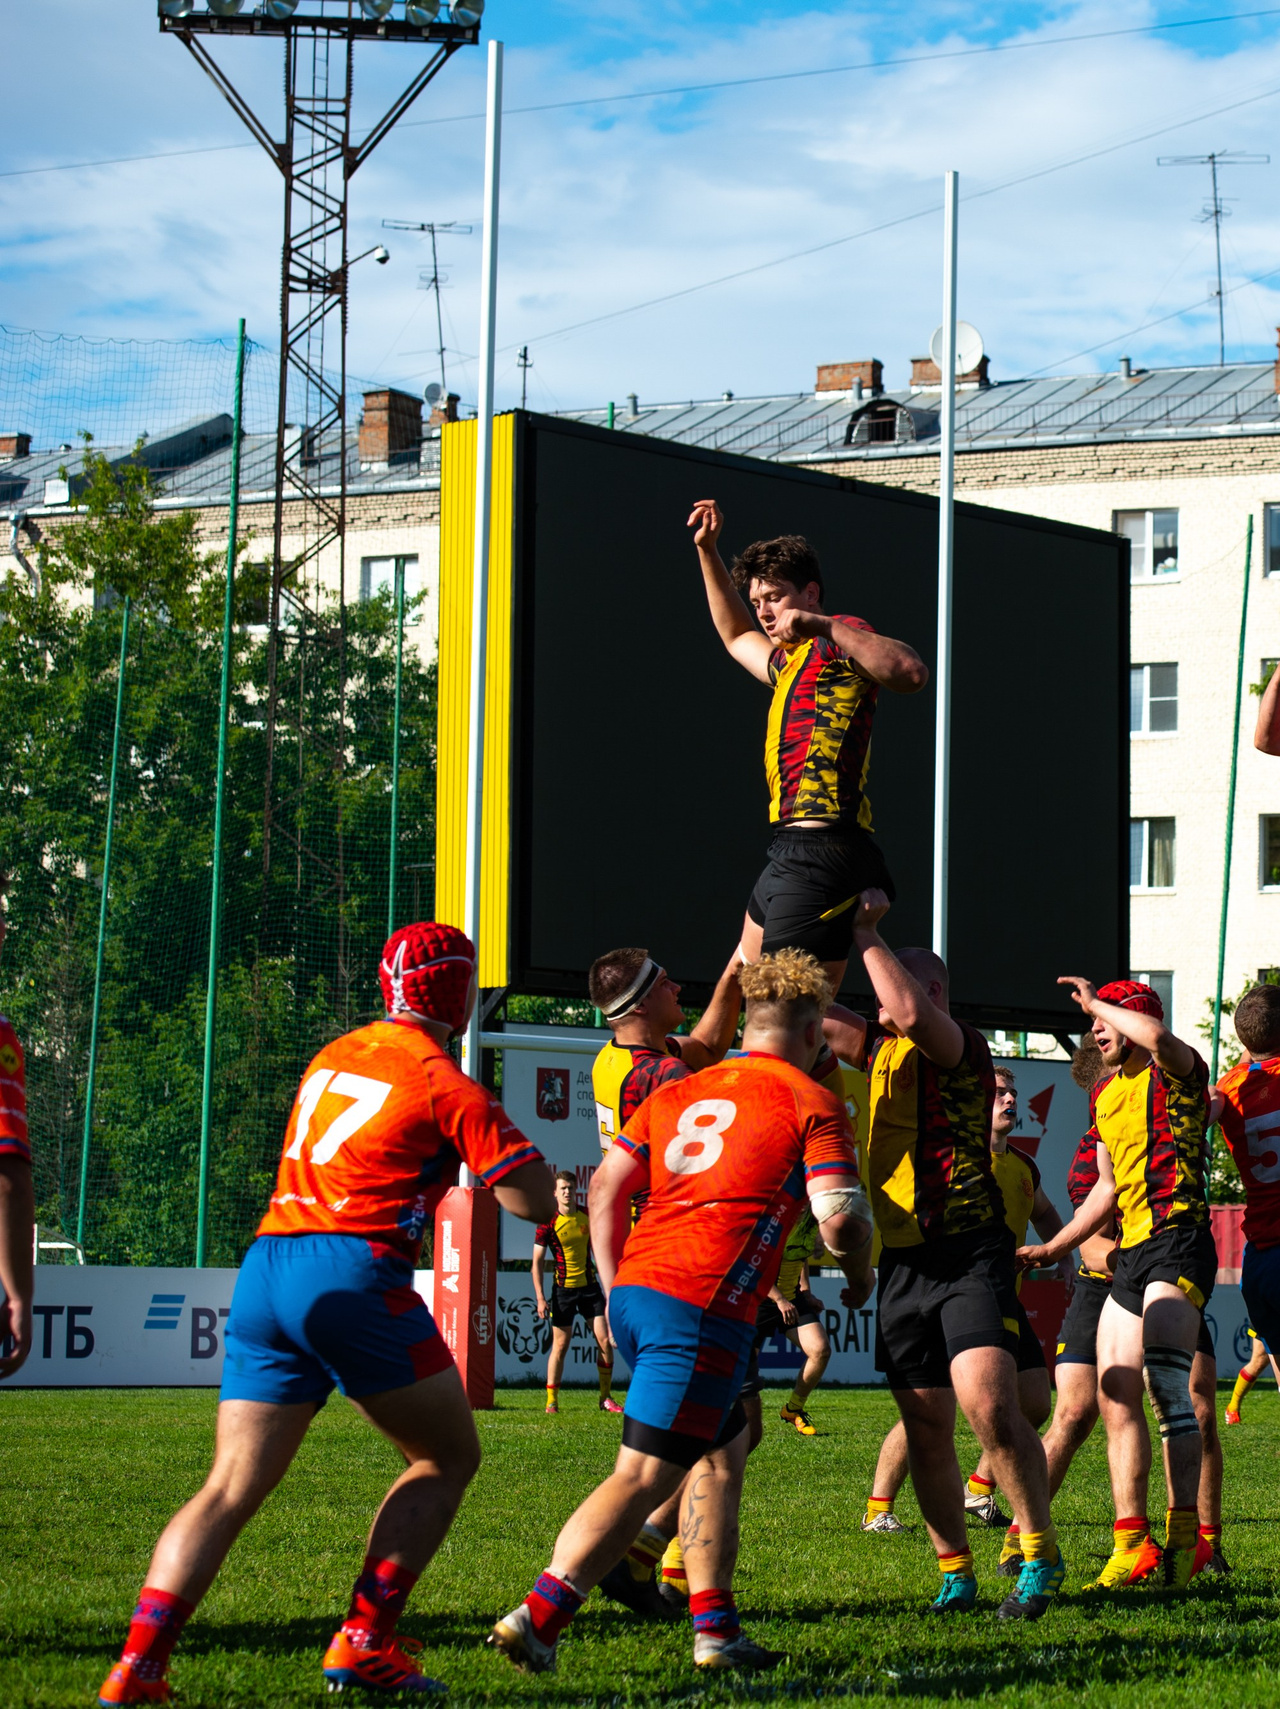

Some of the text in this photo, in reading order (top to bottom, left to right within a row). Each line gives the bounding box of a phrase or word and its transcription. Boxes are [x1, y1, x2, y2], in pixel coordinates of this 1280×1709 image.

[285, 1068, 393, 1165] 17
[664, 1098, 737, 1175] 8
[407, 1194, 427, 1240] OTEM
[727, 1203, 787, 1305] PUBLIC TOTEM
